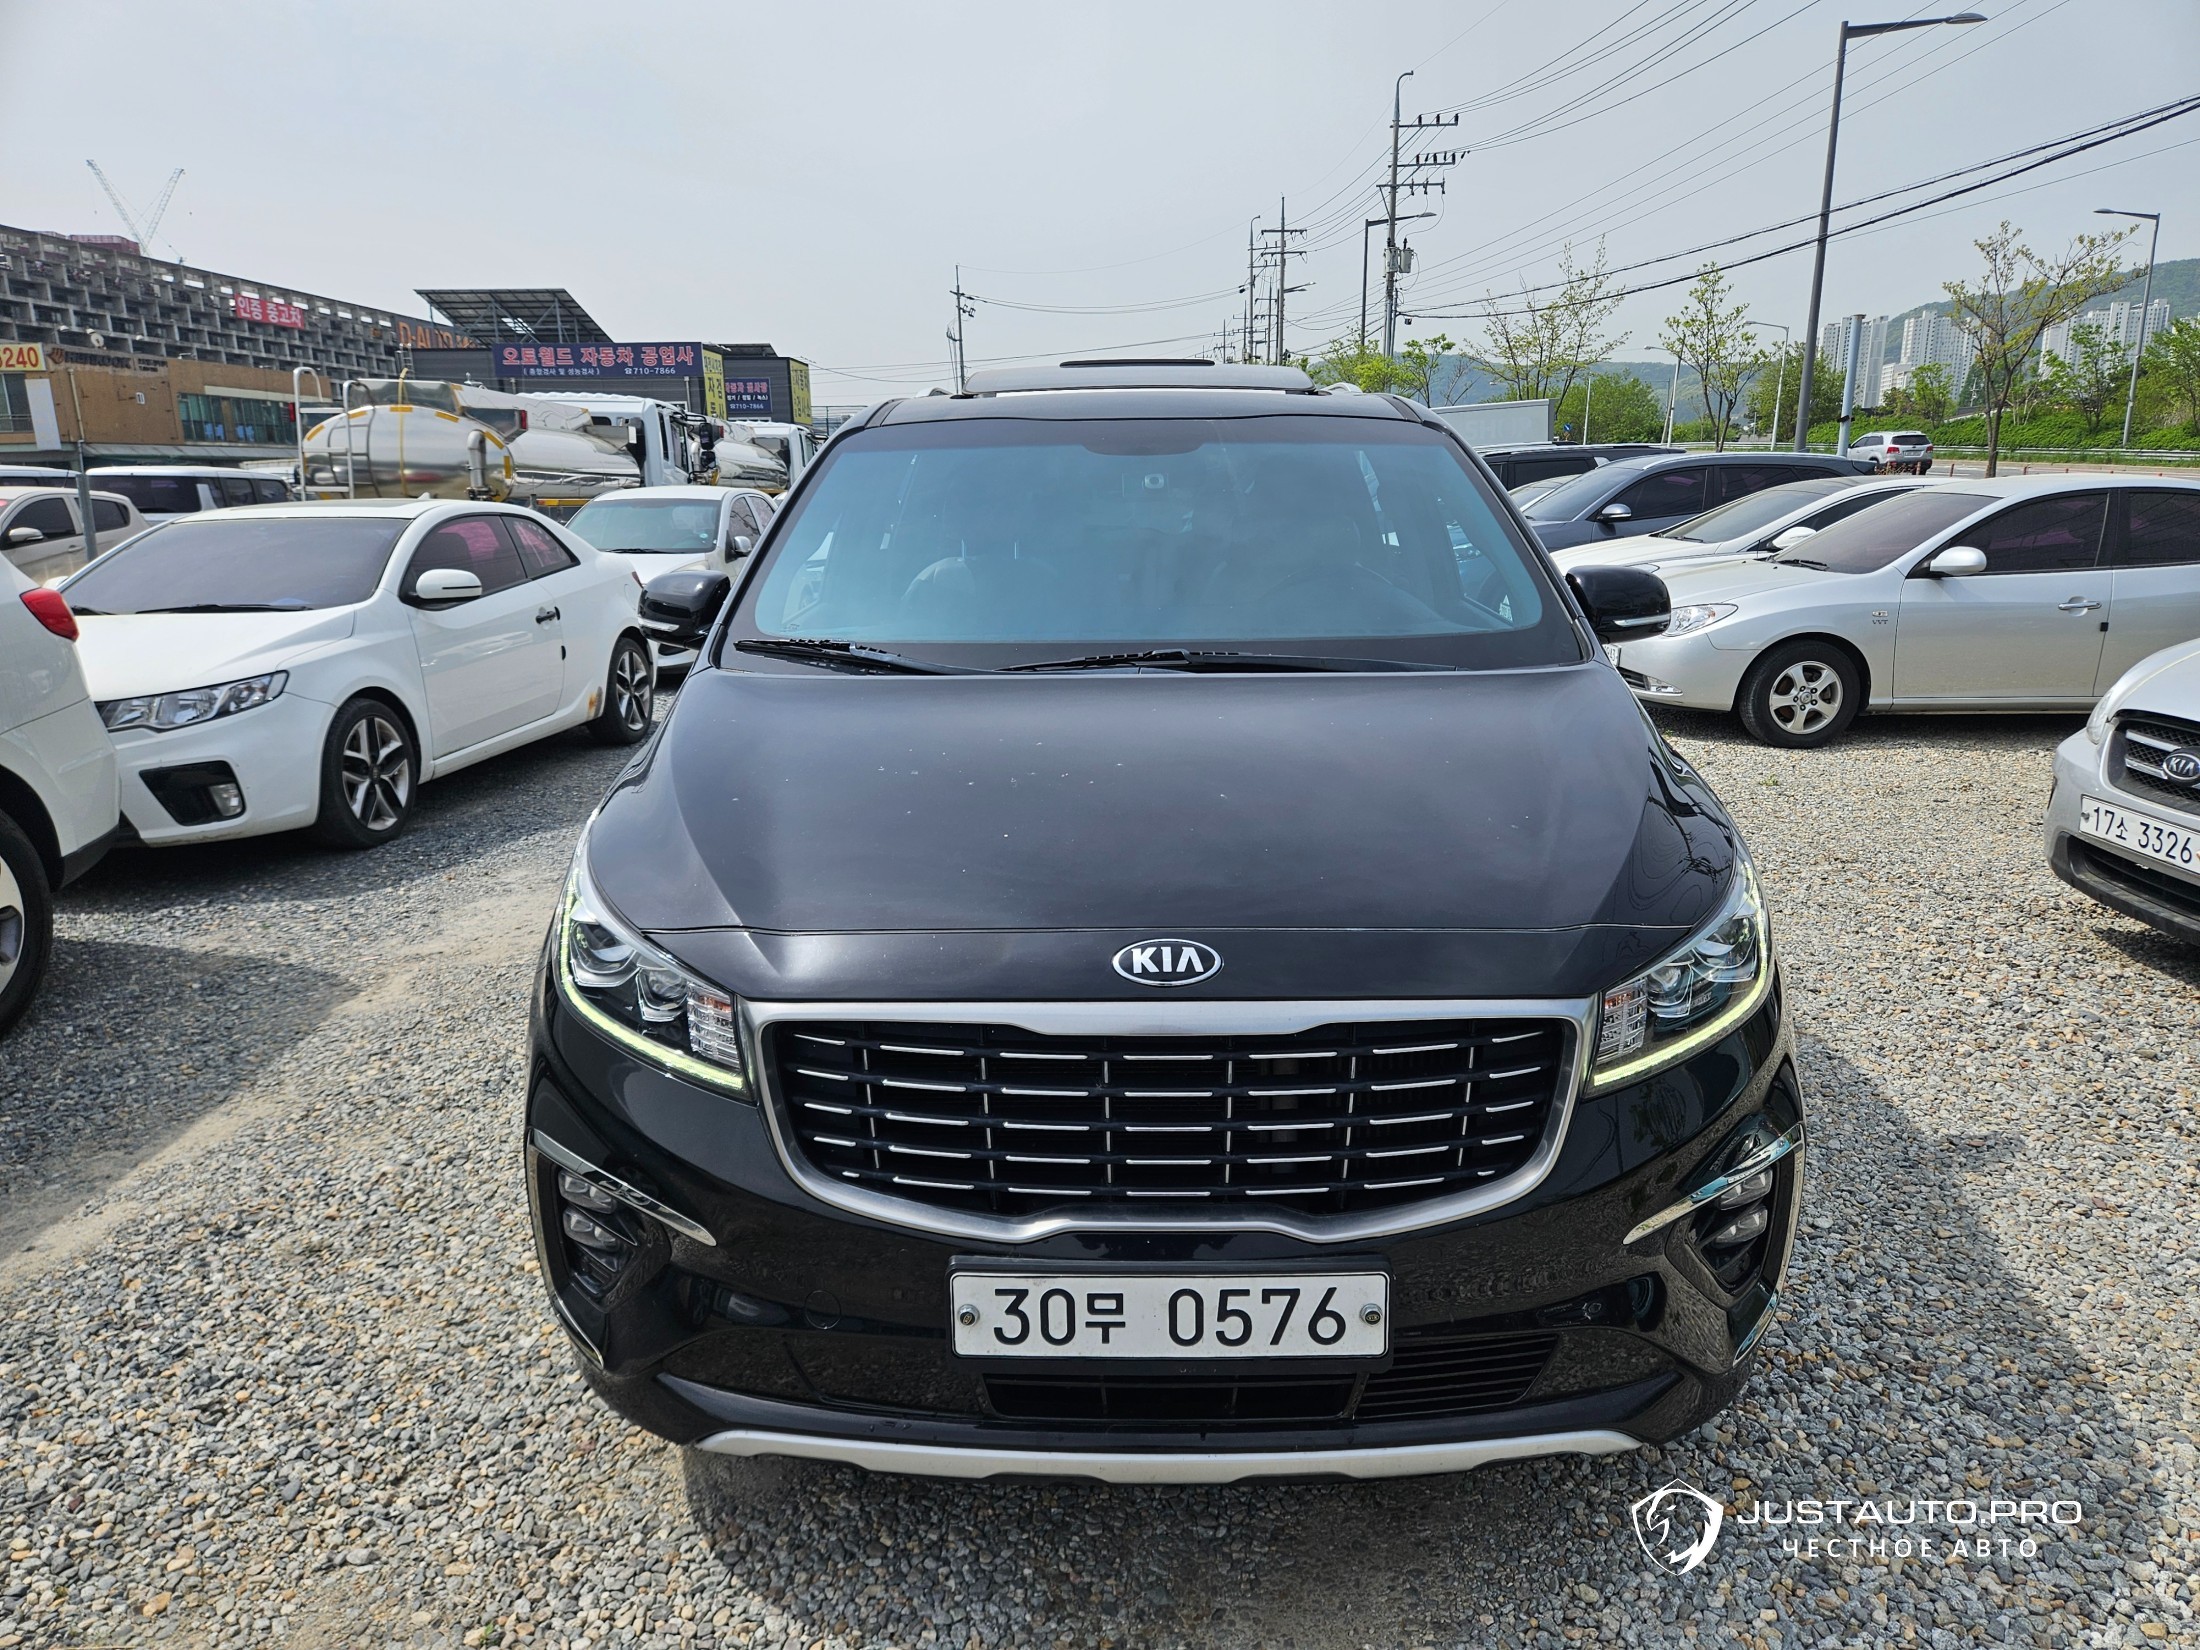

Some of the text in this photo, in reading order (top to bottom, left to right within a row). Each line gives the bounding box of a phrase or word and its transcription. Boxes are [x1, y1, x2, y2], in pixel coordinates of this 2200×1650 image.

[237, 296, 302, 328] 인증 중고차
[0, 346, 39, 368] 240
[502, 345, 694, 367] 오토월드 자동차 공업사
[632, 367, 676, 375] 710-7866
[2168, 757, 2195, 777] KIA
[2093, 806, 2194, 864] 17소 3326
[1131, 946, 1205, 974] KIA
[993, 1286, 1347, 1347] 30무 0576
